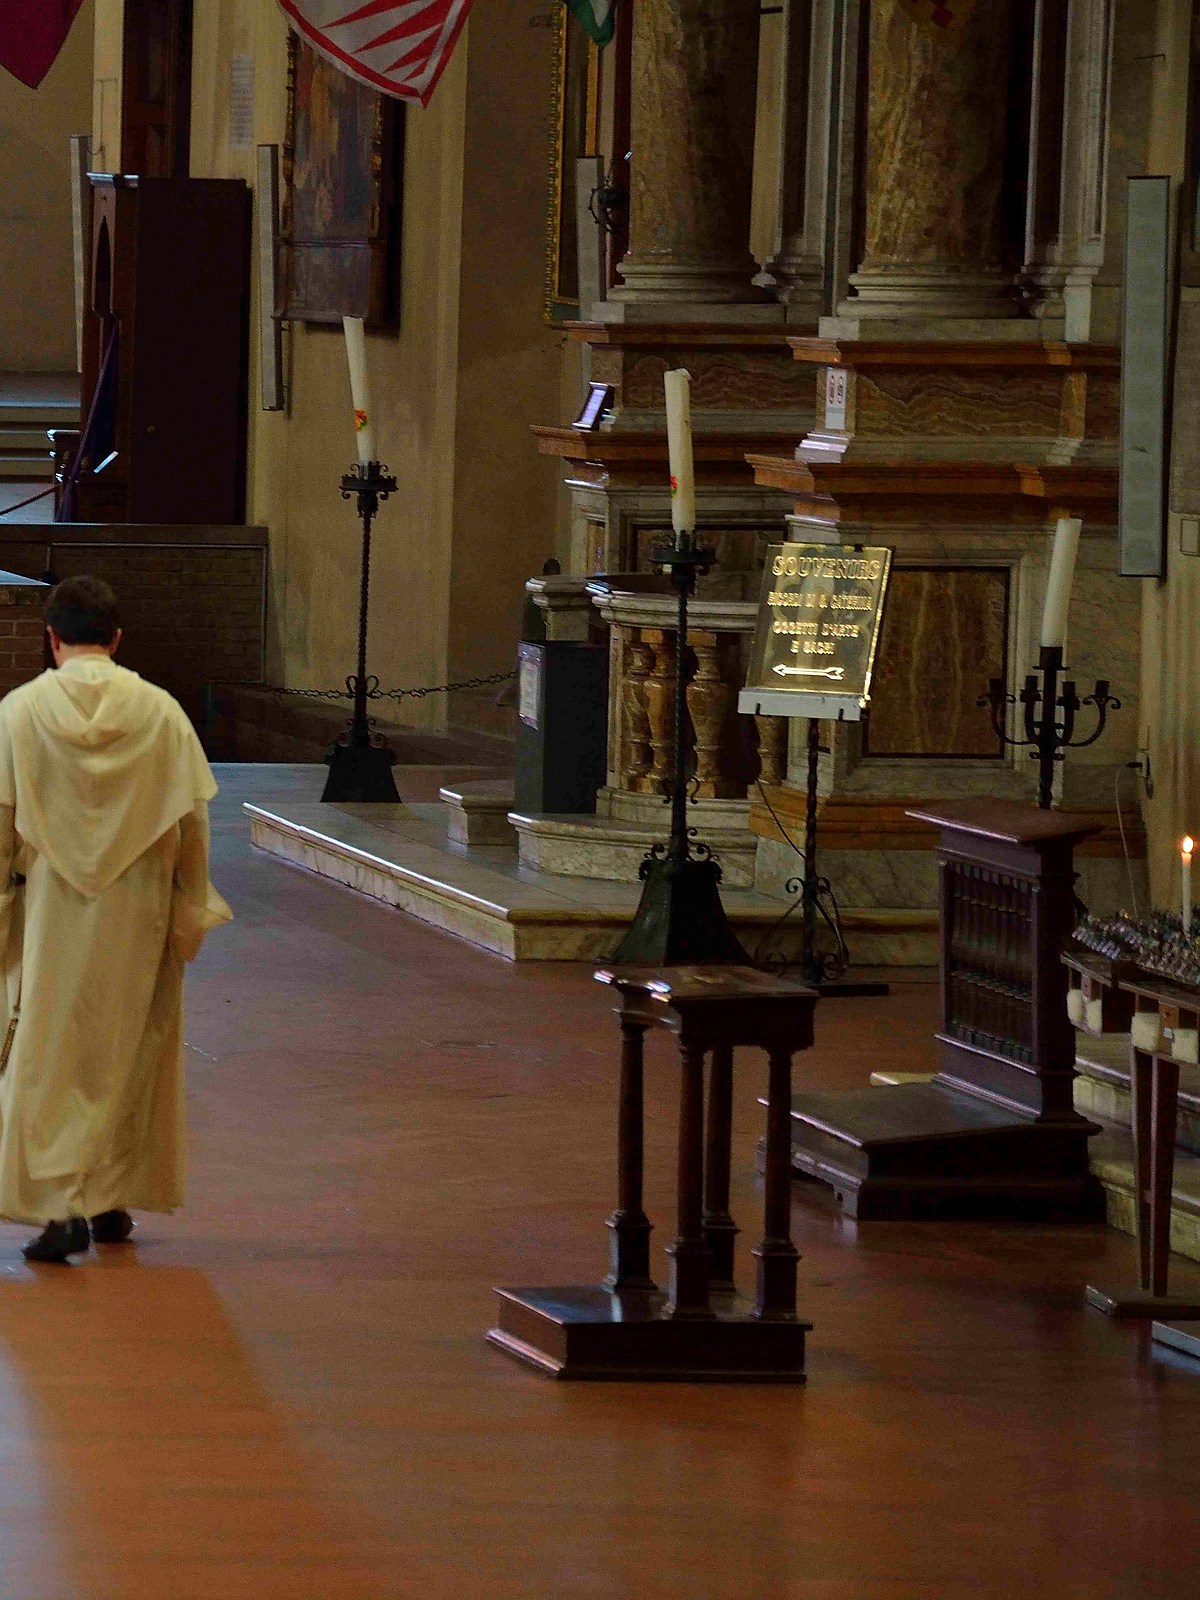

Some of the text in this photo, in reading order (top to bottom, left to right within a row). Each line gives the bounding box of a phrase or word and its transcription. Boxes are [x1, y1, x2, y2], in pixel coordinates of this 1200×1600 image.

[772, 556, 880, 580] SOUVENIRS
[830, 594, 873, 611] CATERINA
[773, 621, 819, 636] OGGETTI
